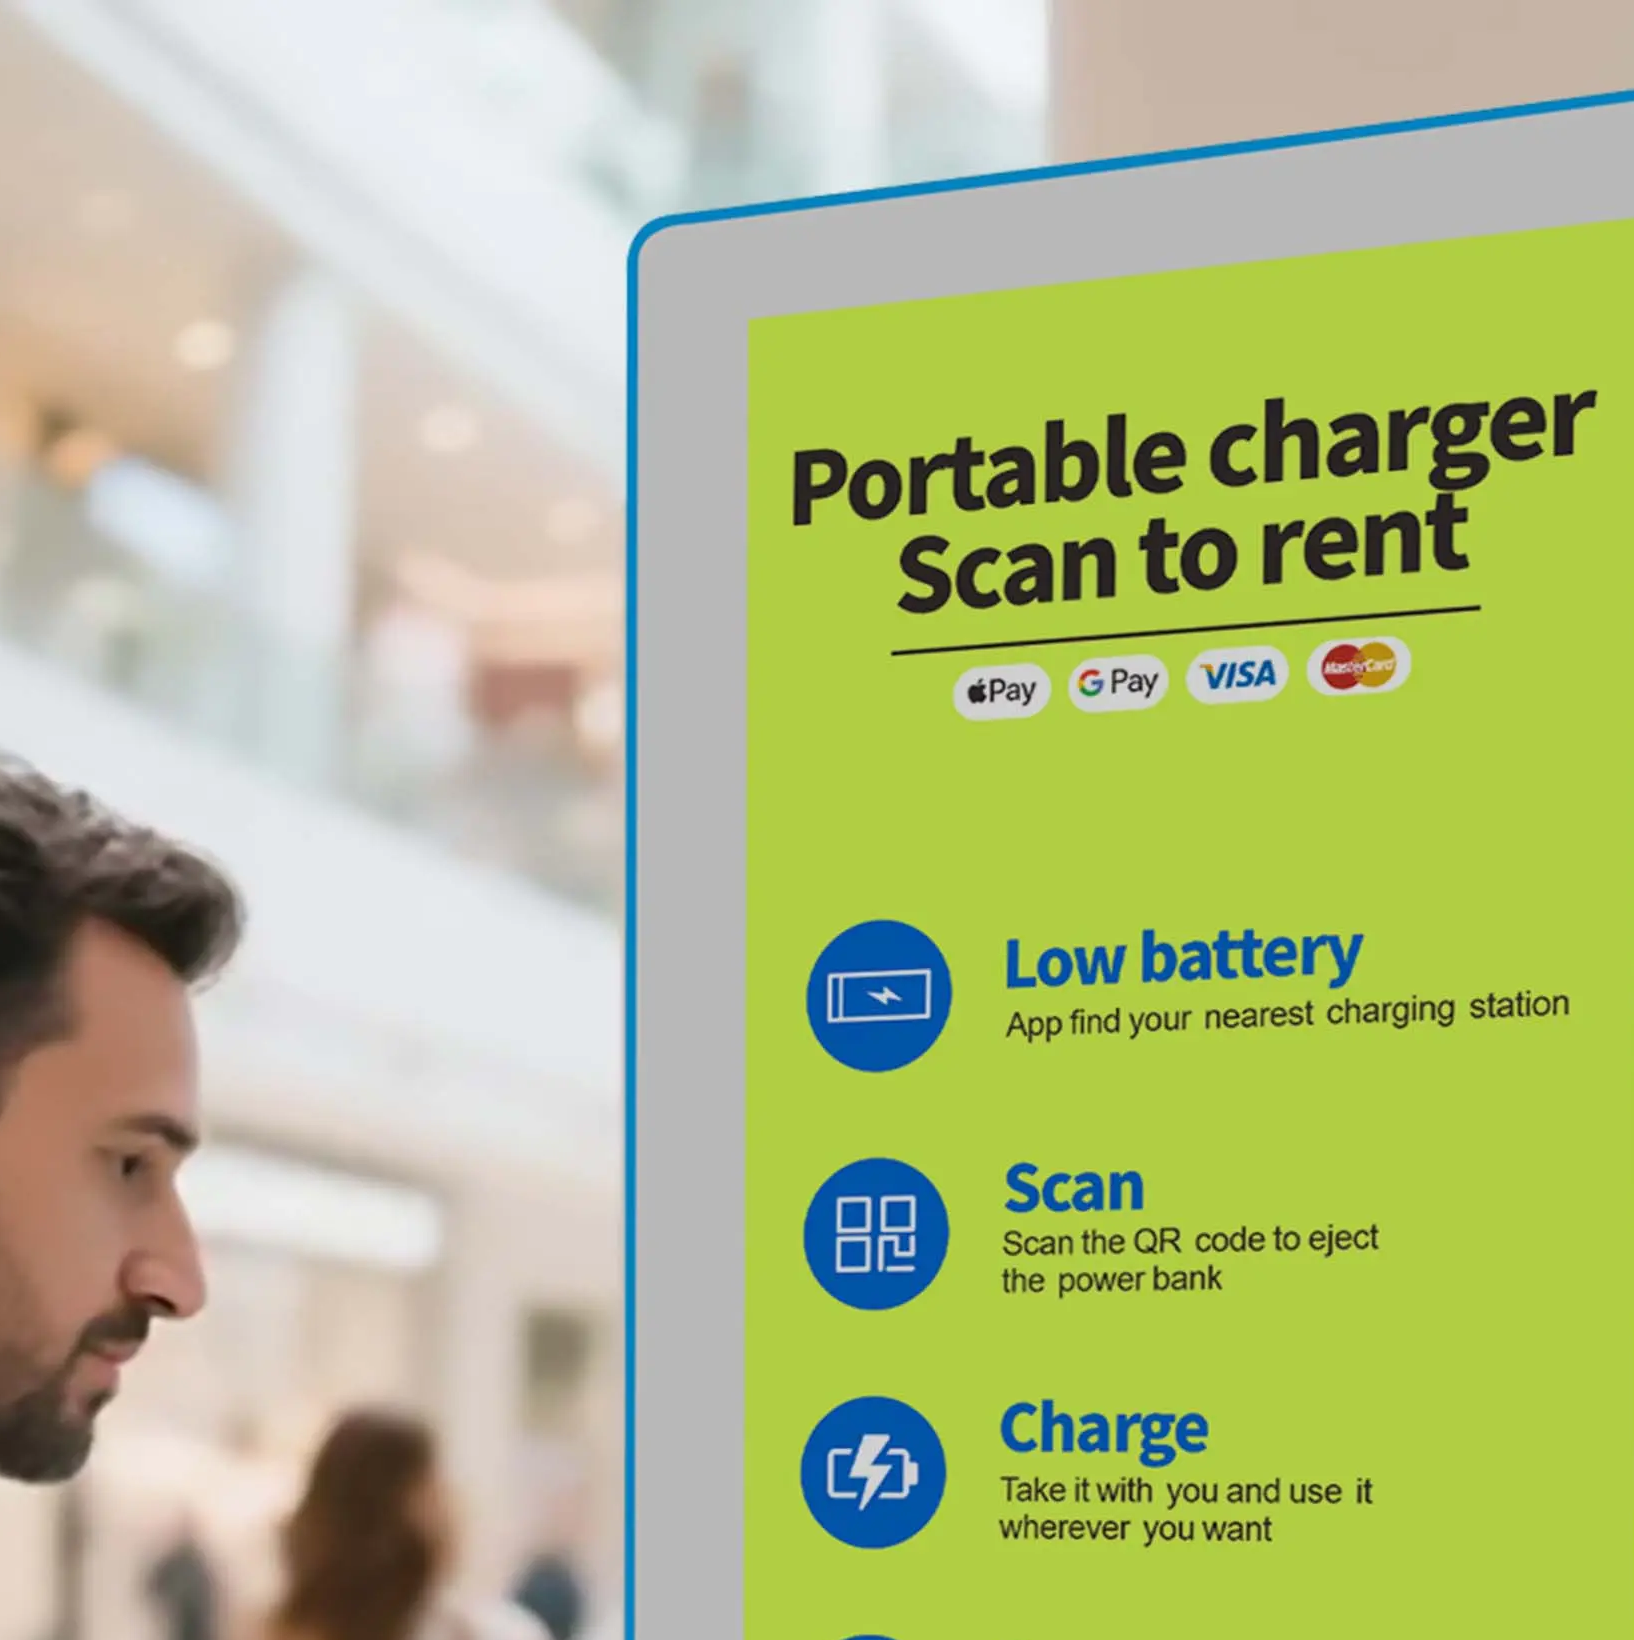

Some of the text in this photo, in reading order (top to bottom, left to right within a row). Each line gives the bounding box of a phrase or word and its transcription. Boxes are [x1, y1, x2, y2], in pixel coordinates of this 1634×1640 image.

[794, 390, 1597, 526] Portable charger
[898, 492, 1469, 613] Scan to rent
[1200, 660, 1276, 689] VISA
[1324, 658, 1396, 675] MasterCard
[990, 678, 1036, 706] Pay
[1112, 669, 1158, 698] Pay
[1007, 929, 1364, 989] Low battery
[1006, 990, 1569, 1043] App find your nearest charging station
[1006, 1162, 1143, 1213] Scan
[1003, 1224, 1378, 1257] Scan the QR code to eject
[1002, 1265, 1222, 1298] the power bank
[1001, 1400, 1208, 1468] Charge
[1001, 1476, 1372, 1510] Take it with you and use it
[999, 1514, 1272, 1547] wherever you want
